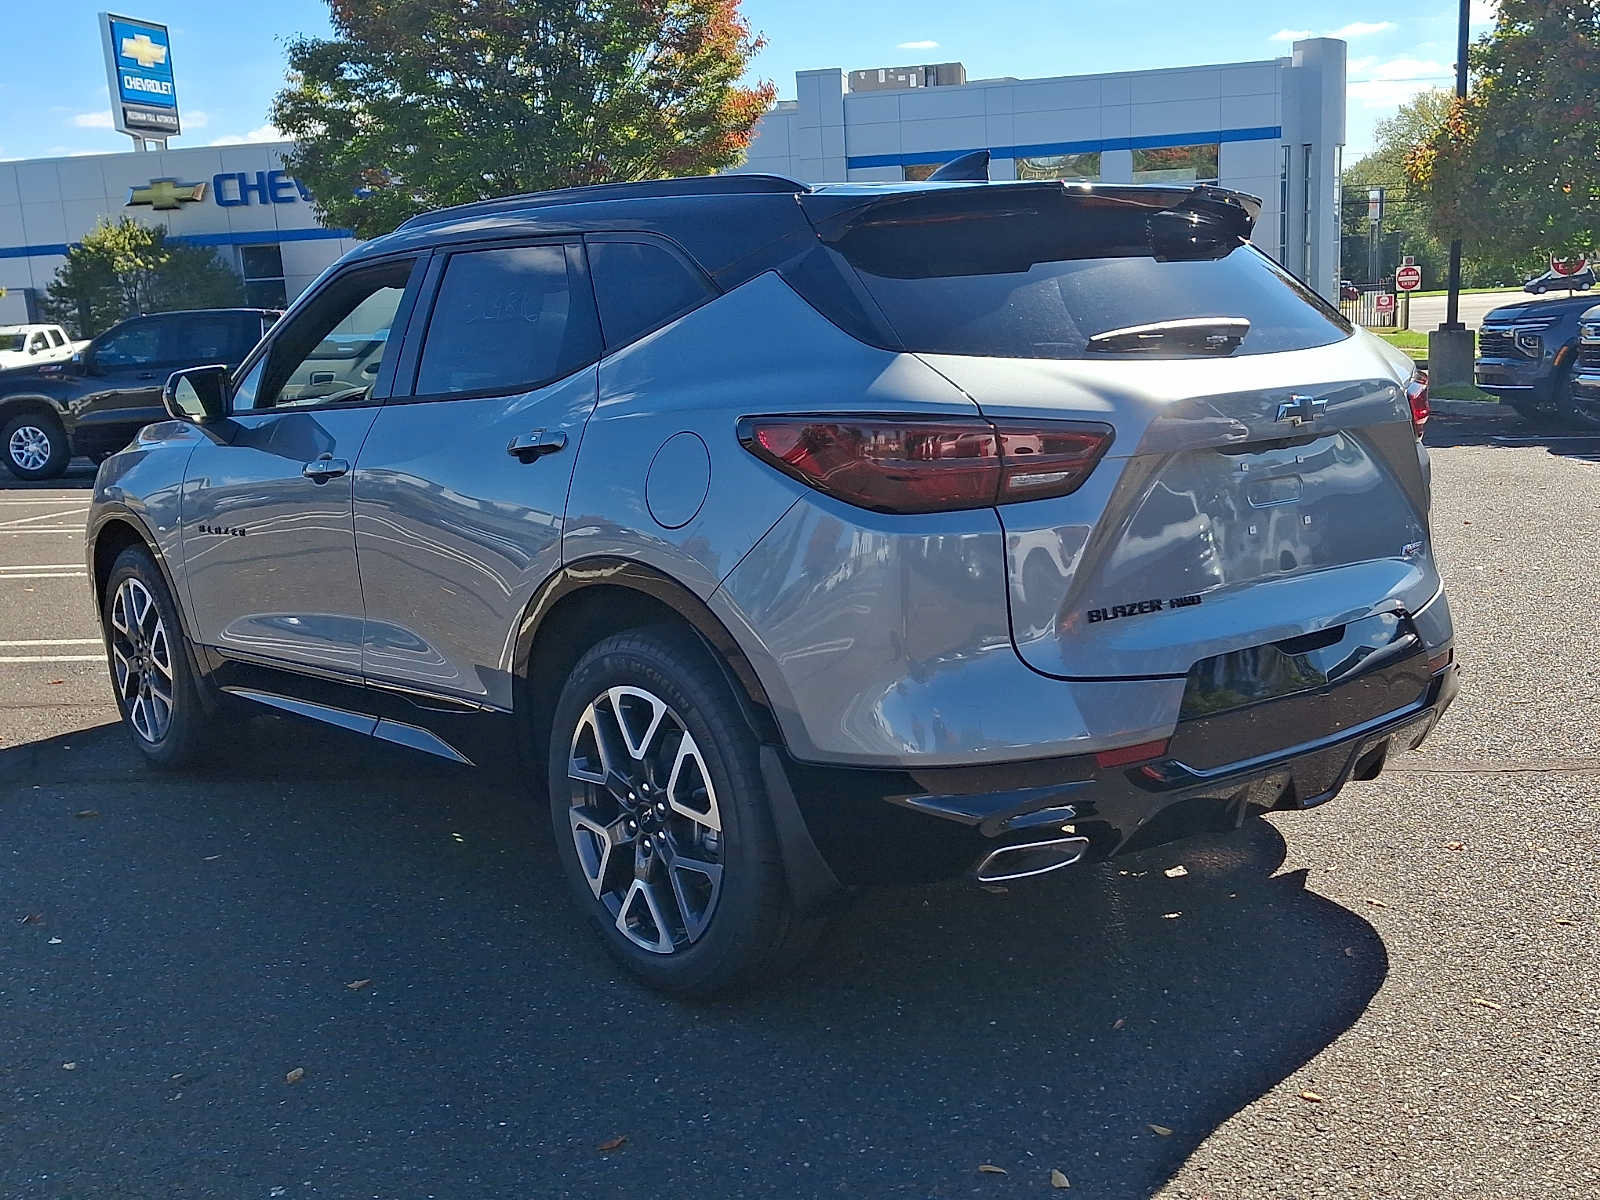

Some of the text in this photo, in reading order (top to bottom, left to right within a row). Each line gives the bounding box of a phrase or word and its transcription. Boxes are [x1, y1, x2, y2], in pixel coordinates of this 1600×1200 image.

[123, 76, 172, 95] CHEVROLET
[1087, 594, 1203, 623] BLAZER AWD
